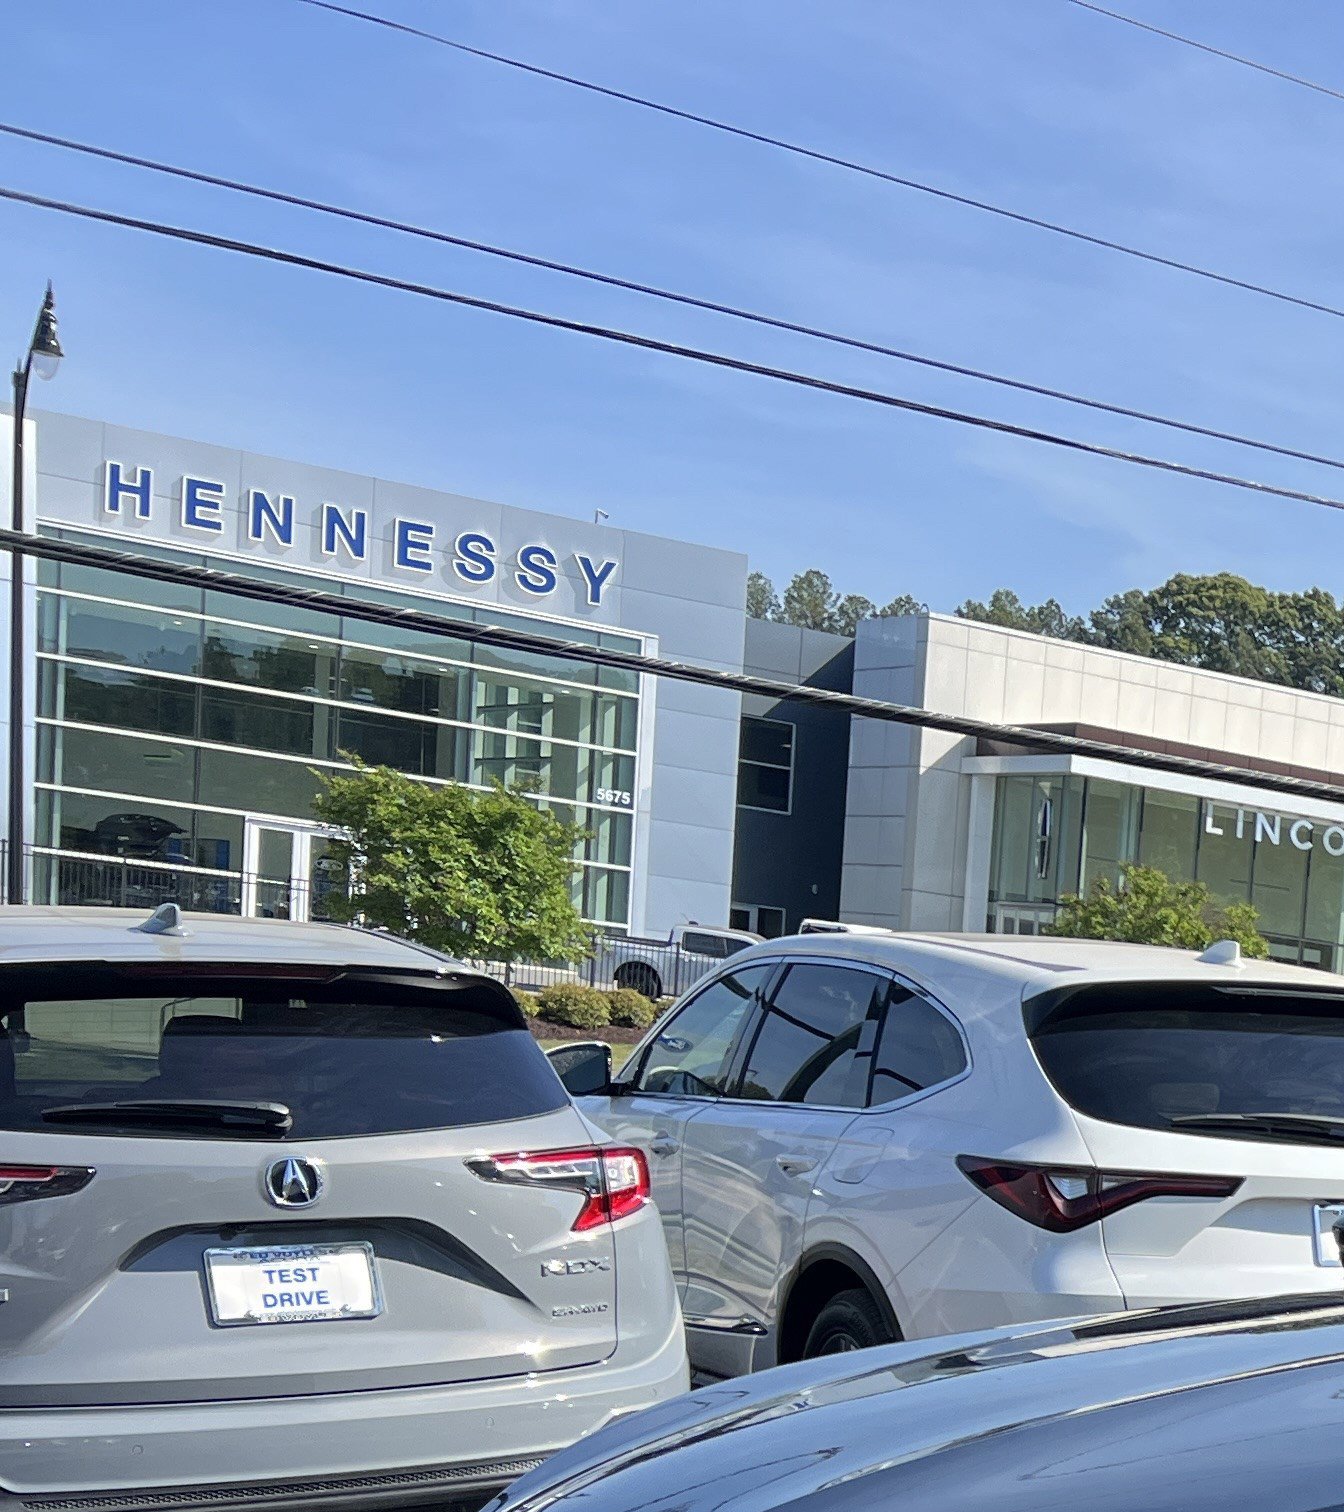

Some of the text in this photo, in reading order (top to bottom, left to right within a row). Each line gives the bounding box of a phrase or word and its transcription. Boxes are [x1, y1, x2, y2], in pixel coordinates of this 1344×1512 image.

[104, 460, 619, 607] HENNESSY
[597, 788, 631, 805] 5675
[263, 1267, 320, 1284] TEST
[262, 1290, 330, 1308] DRIVE
